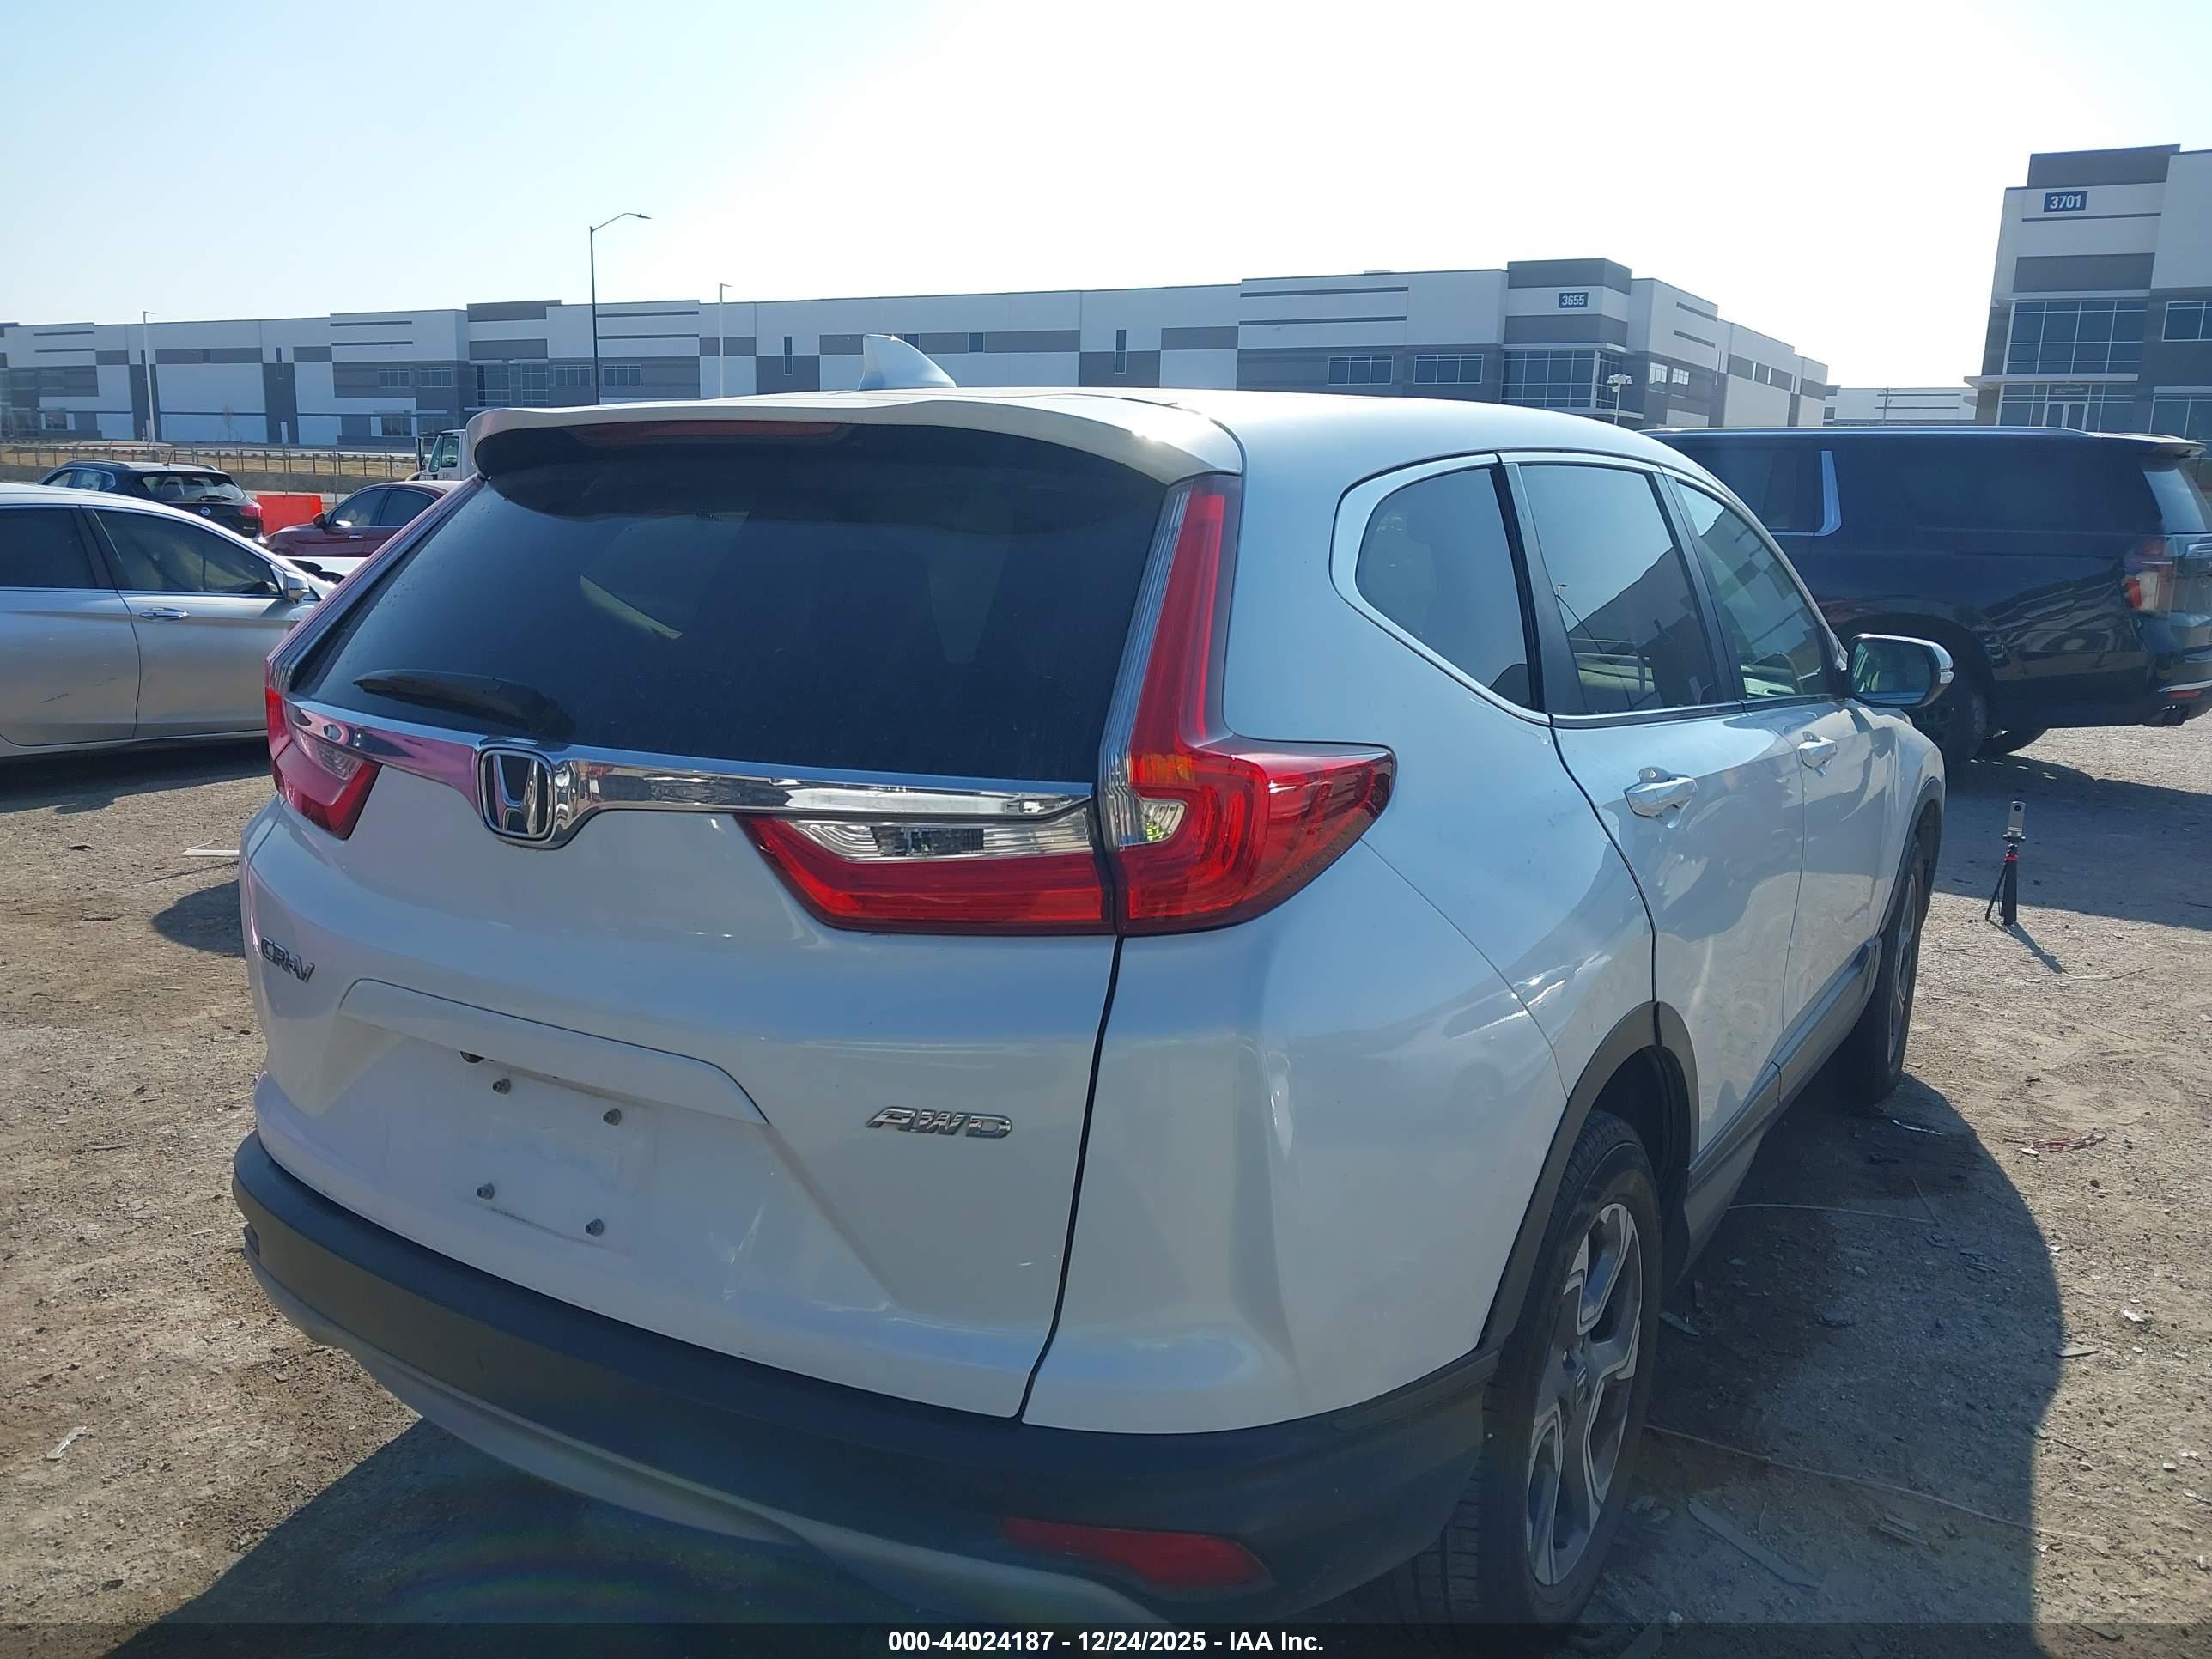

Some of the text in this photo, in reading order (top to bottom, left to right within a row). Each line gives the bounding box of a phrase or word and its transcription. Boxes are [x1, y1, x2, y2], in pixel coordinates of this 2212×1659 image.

[2050, 195, 2081, 209] 3701
[1562, 295, 1585, 306] 3655
[261, 937, 315, 982] CR-V
[866, 1106, 1012, 1139] AWD
